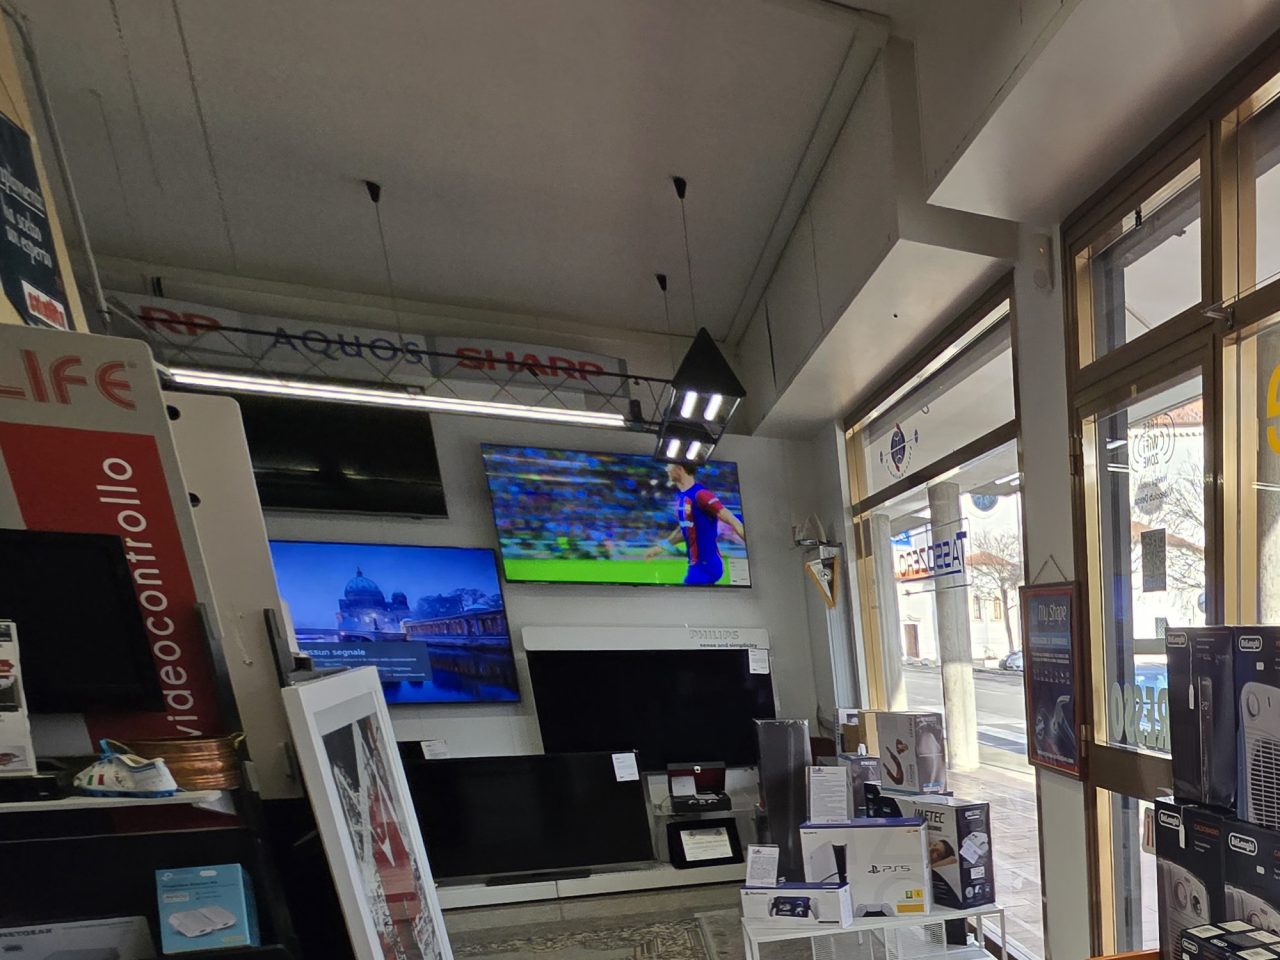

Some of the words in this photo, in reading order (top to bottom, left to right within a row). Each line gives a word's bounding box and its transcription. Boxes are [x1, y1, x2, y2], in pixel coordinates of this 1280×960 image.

[271, 326, 423, 365] AQUOS
[456, 347, 603, 381] SHARP
[100, 456, 203, 738] videocontrollo
[690, 630, 740, 640] PHILIPS
[332, 648, 366, 657] segnale
[914, 808, 945, 824] IMETEC
